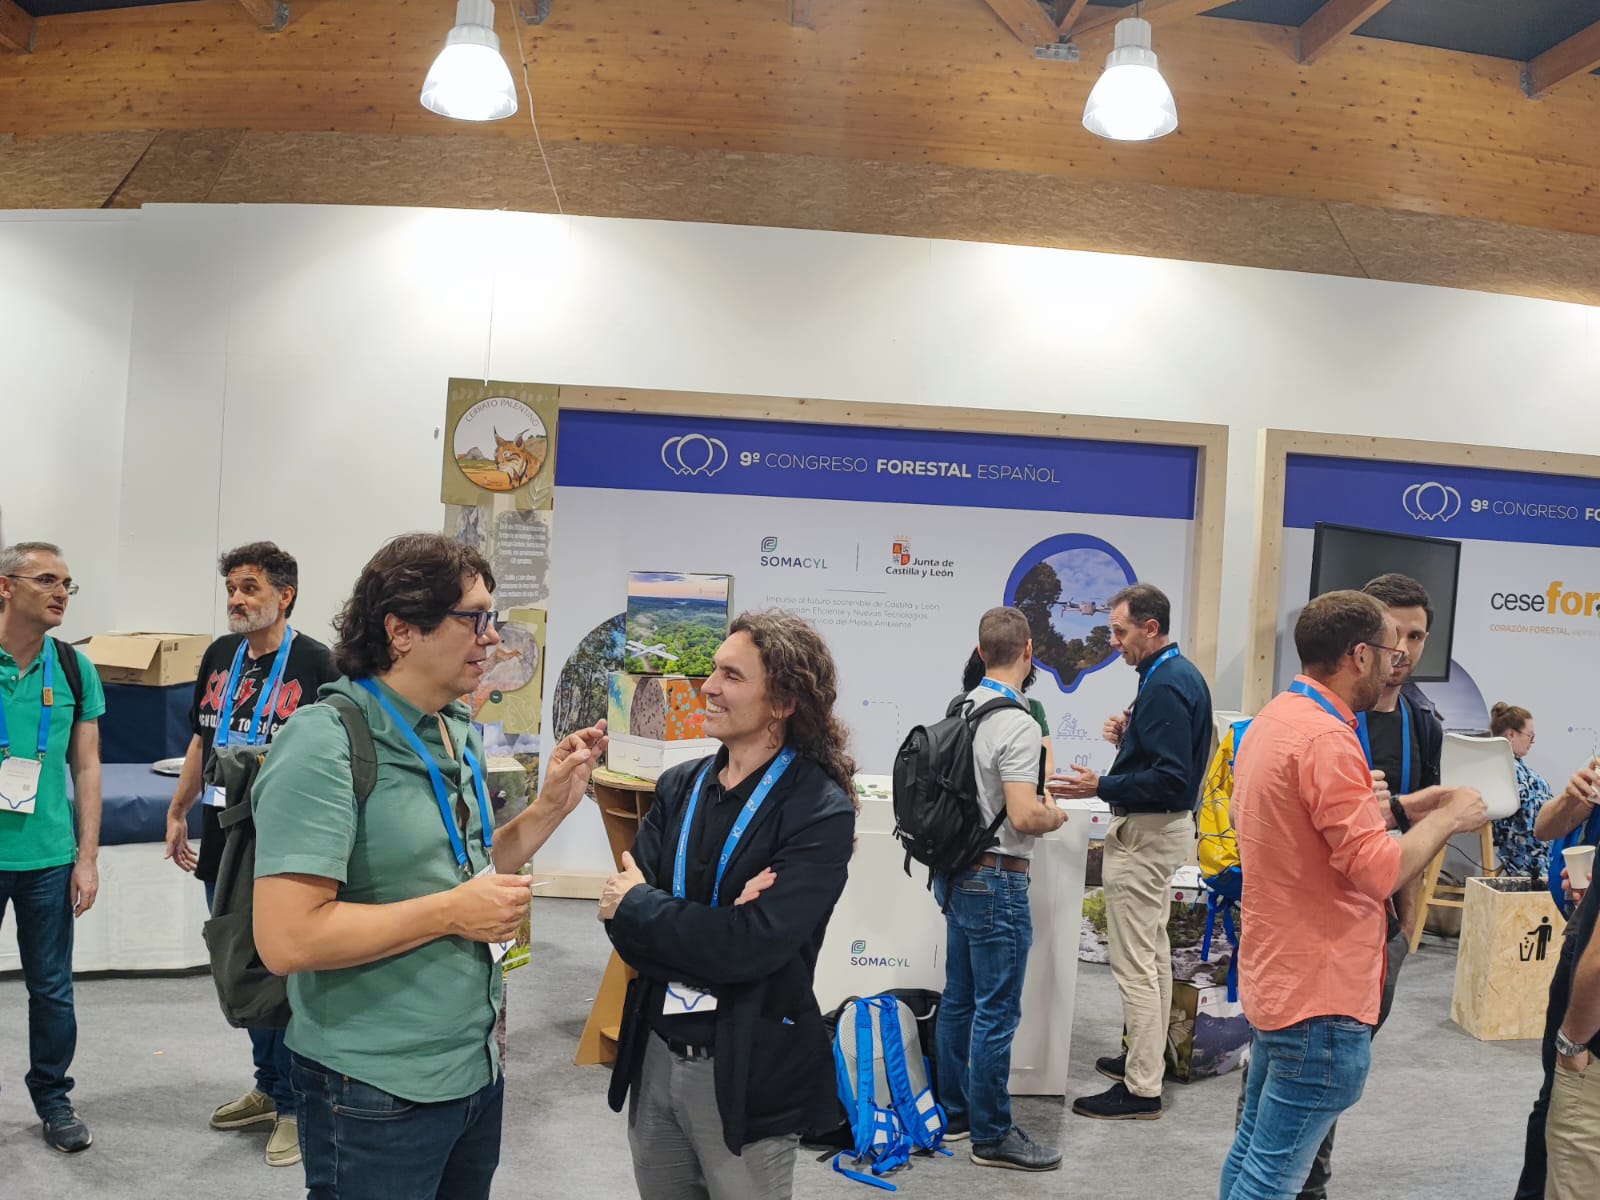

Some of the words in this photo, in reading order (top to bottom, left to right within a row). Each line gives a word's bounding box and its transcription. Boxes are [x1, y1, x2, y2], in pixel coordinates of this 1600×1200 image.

[465, 399, 498, 423] CERRATO
[500, 398, 540, 427] PALENTINO
[765, 452, 868, 473] CONGRESO
[876, 458, 972, 478] FORESTAL
[977, 463, 1061, 483] ESPAÑOL
[1492, 500, 1579, 520] CONGRESO
[760, 555, 828, 569] SOMACYL
[912, 557, 940, 567] Junta
[941, 559, 955, 568] de
[885, 566, 920, 576] Castilla
[921, 568, 928, 578] y
[930, 568, 955, 577] León
[850, 956, 910, 968] SOMACYL
